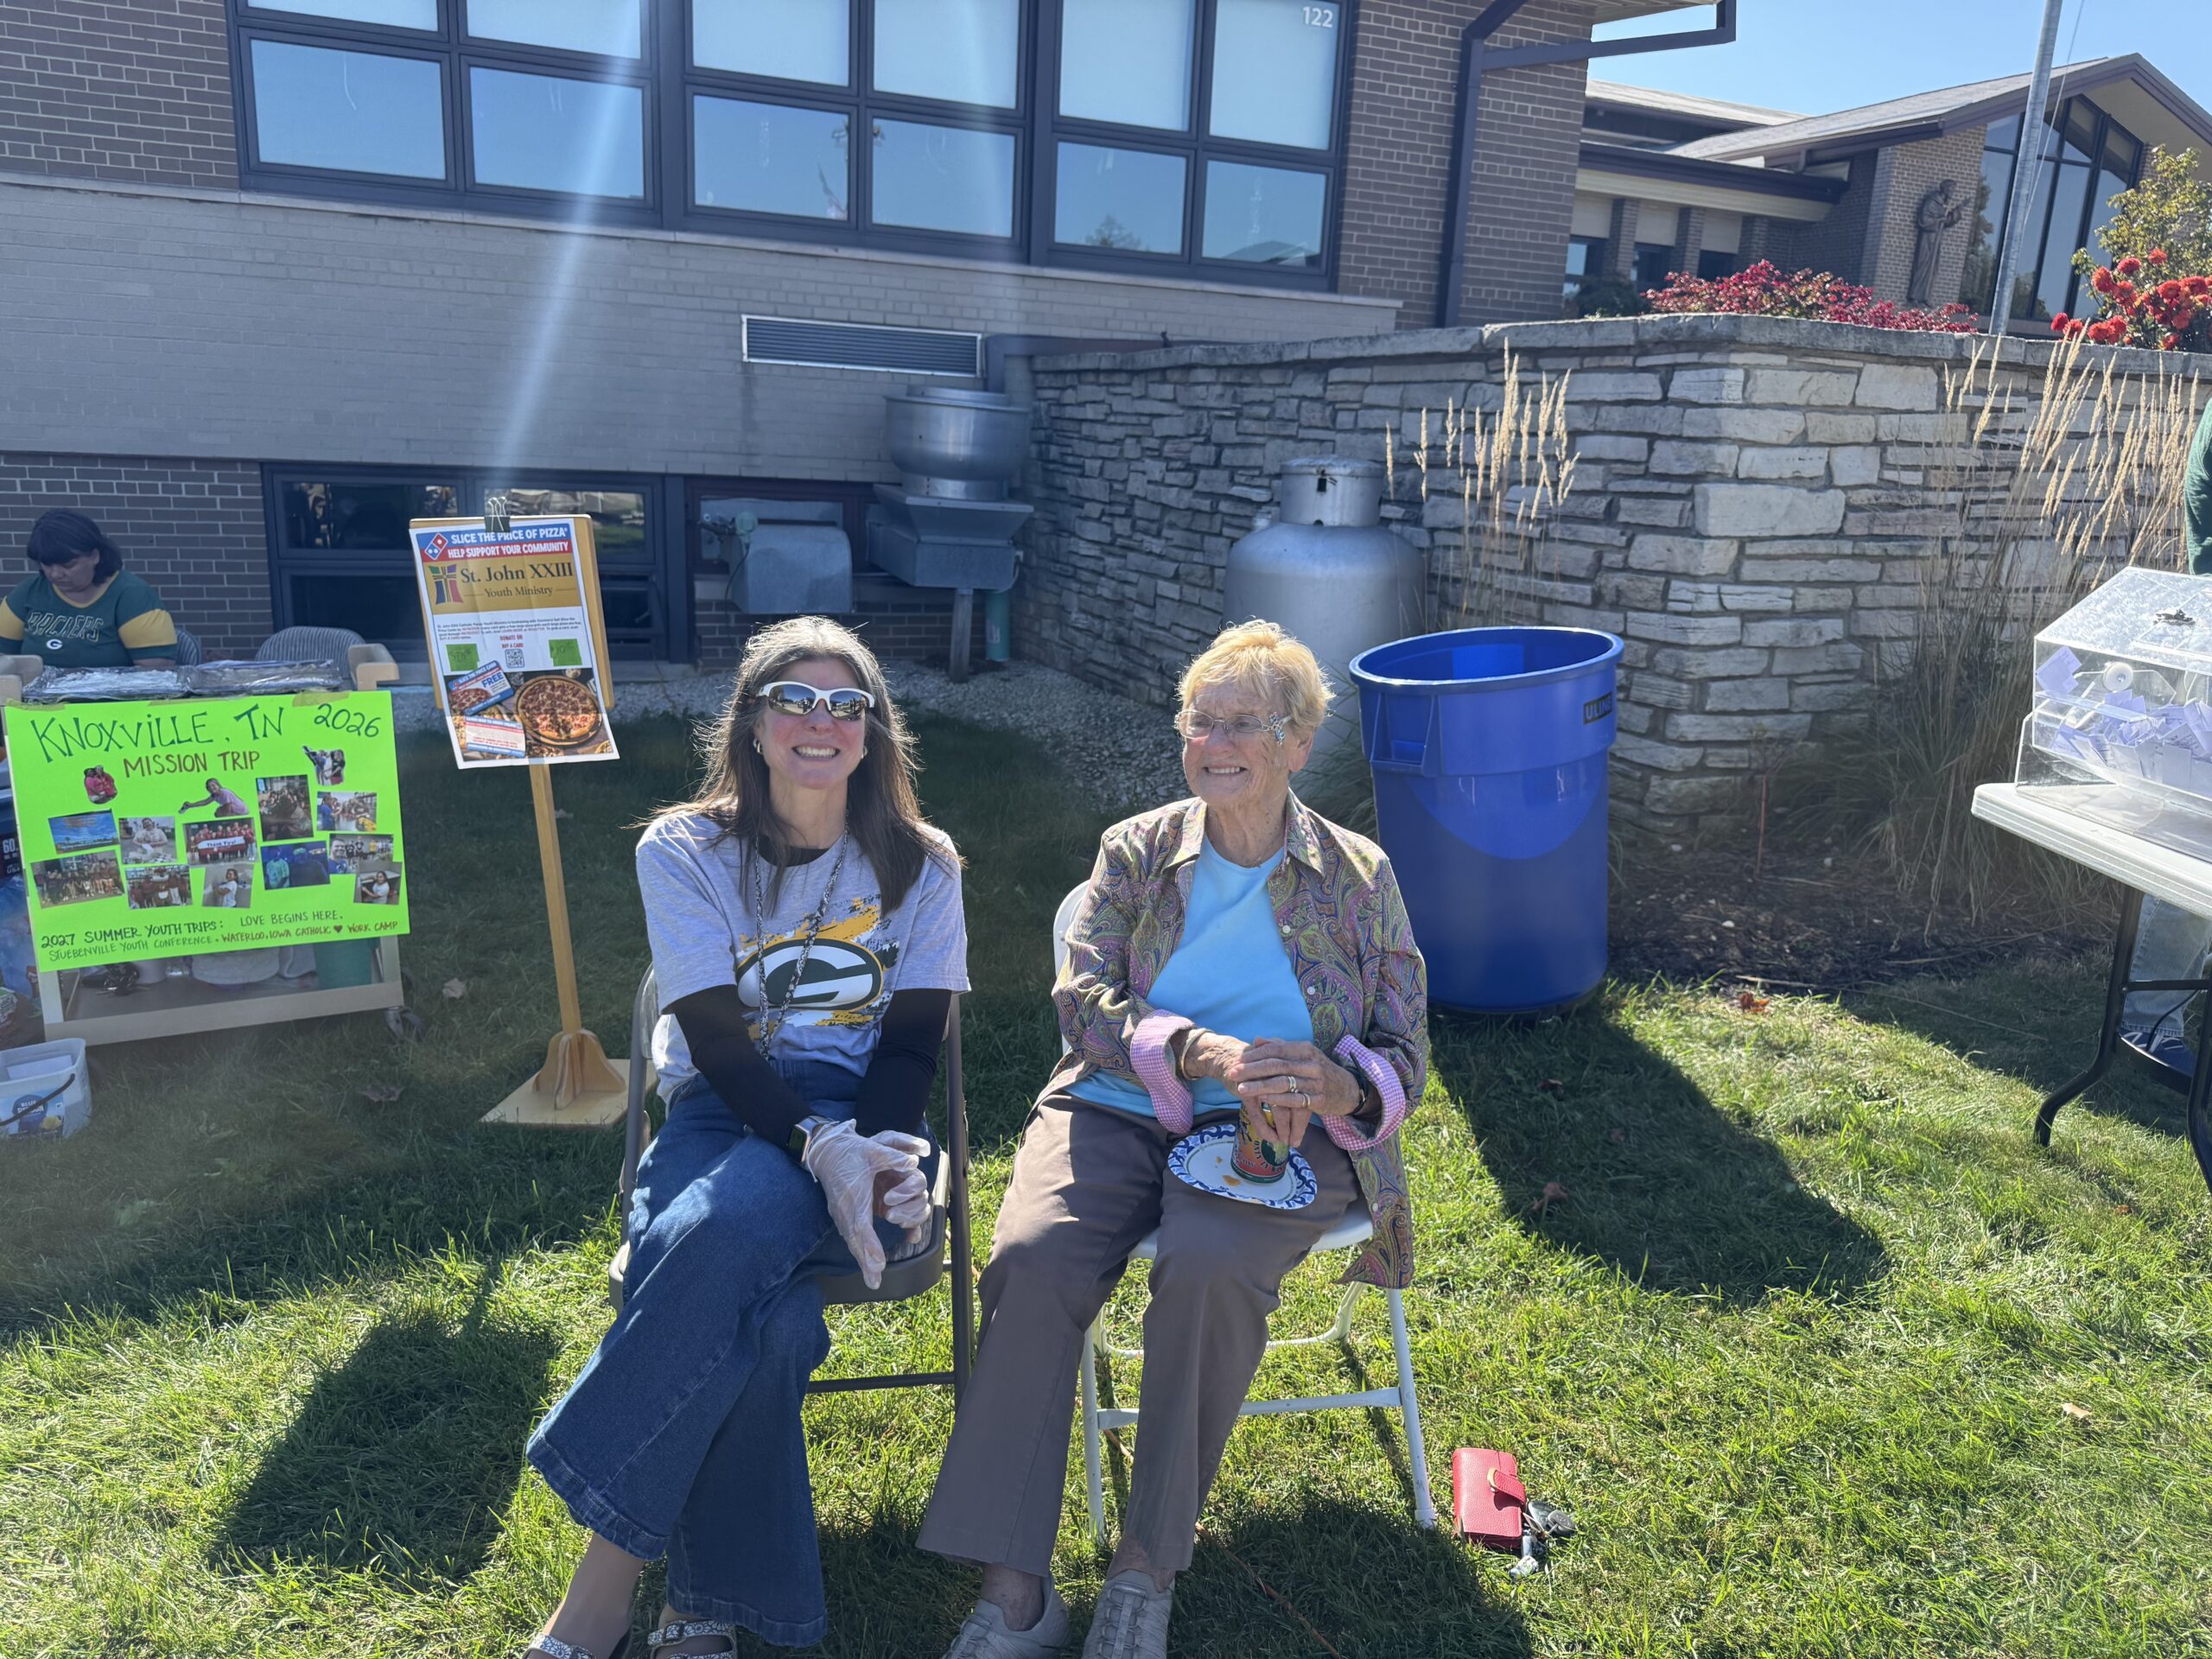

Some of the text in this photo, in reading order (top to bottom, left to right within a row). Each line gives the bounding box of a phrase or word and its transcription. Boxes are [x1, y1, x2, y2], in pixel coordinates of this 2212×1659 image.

[1303, 6, 1333, 28] 122
[451, 533, 476, 544] SLICE
[478, 531, 496, 542] THE
[498, 530, 524, 541] PRICE
[525, 529, 537, 538] OF
[448, 542, 569, 558] HELP SUPPORT YOUR COMMUNITY
[461, 563, 573, 583] St. John XXIII
[485, 587, 553, 598] Youth Ministry
[481, 672, 504, 688] FREE
[234, 703, 283, 741] TN
[314, 703, 380, 737] 2026
[123, 750, 260, 778] MISSION TRIP
[240, 910, 343, 927] LOVE BEGINS HERE.
[41, 920, 224, 949] 2027 SUMMER YOUTH TRIPS:
[49, 944, 116, 962] STUEBENVILLE
[120, 939, 149, 951] YOUTH
[154, 935, 212, 948] CONFERENCE
[269, 928, 292, 938] IOWA
[296, 925, 331, 937] CATHOLIC
[346, 923, 372, 934] WORK
[374, 920, 398, 931] CAMP
[737, 944, 874, 1008] G
